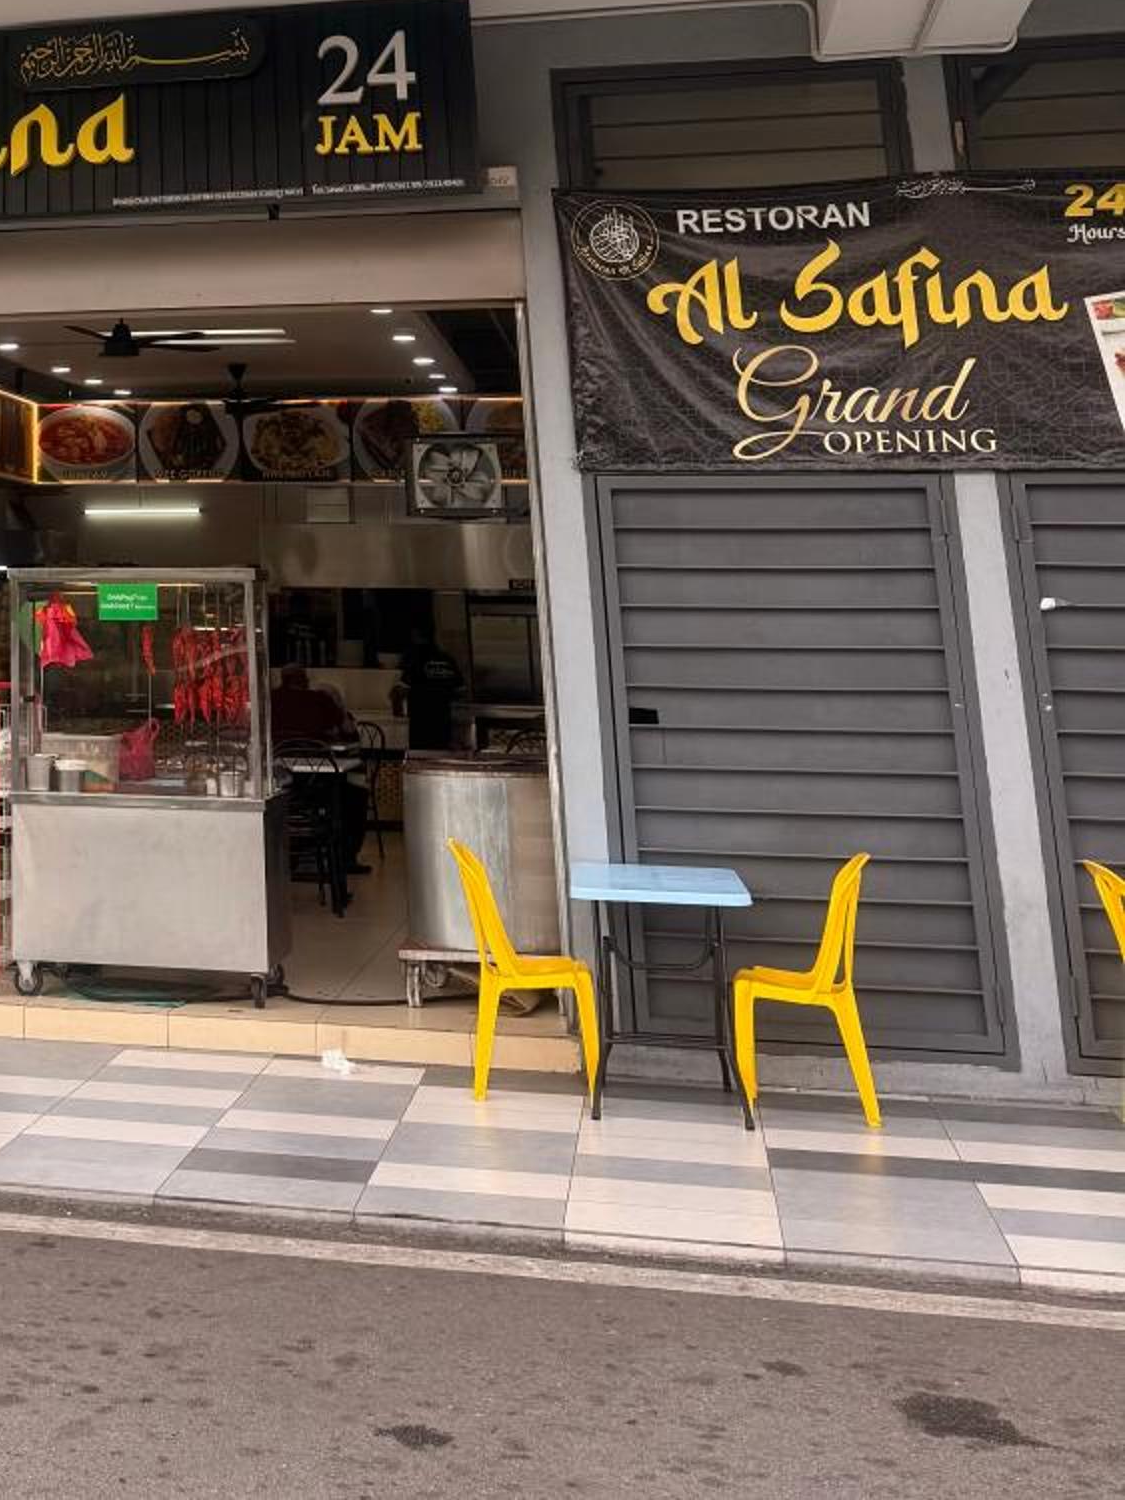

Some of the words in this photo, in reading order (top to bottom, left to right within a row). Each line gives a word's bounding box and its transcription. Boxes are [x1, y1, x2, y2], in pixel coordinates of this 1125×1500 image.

[317, 29, 417, 105] 24
[315, 111, 422, 155] JAM
[676, 201, 871, 234] RESTORAN
[1064, 182, 1125, 218] 24
[1066, 222, 1125, 245] Hours
[646, 256, 758, 345] Al
[779, 239, 1070, 349] Safina
[732, 345, 977, 461] Grand
[822, 428, 998, 455] OPENING
